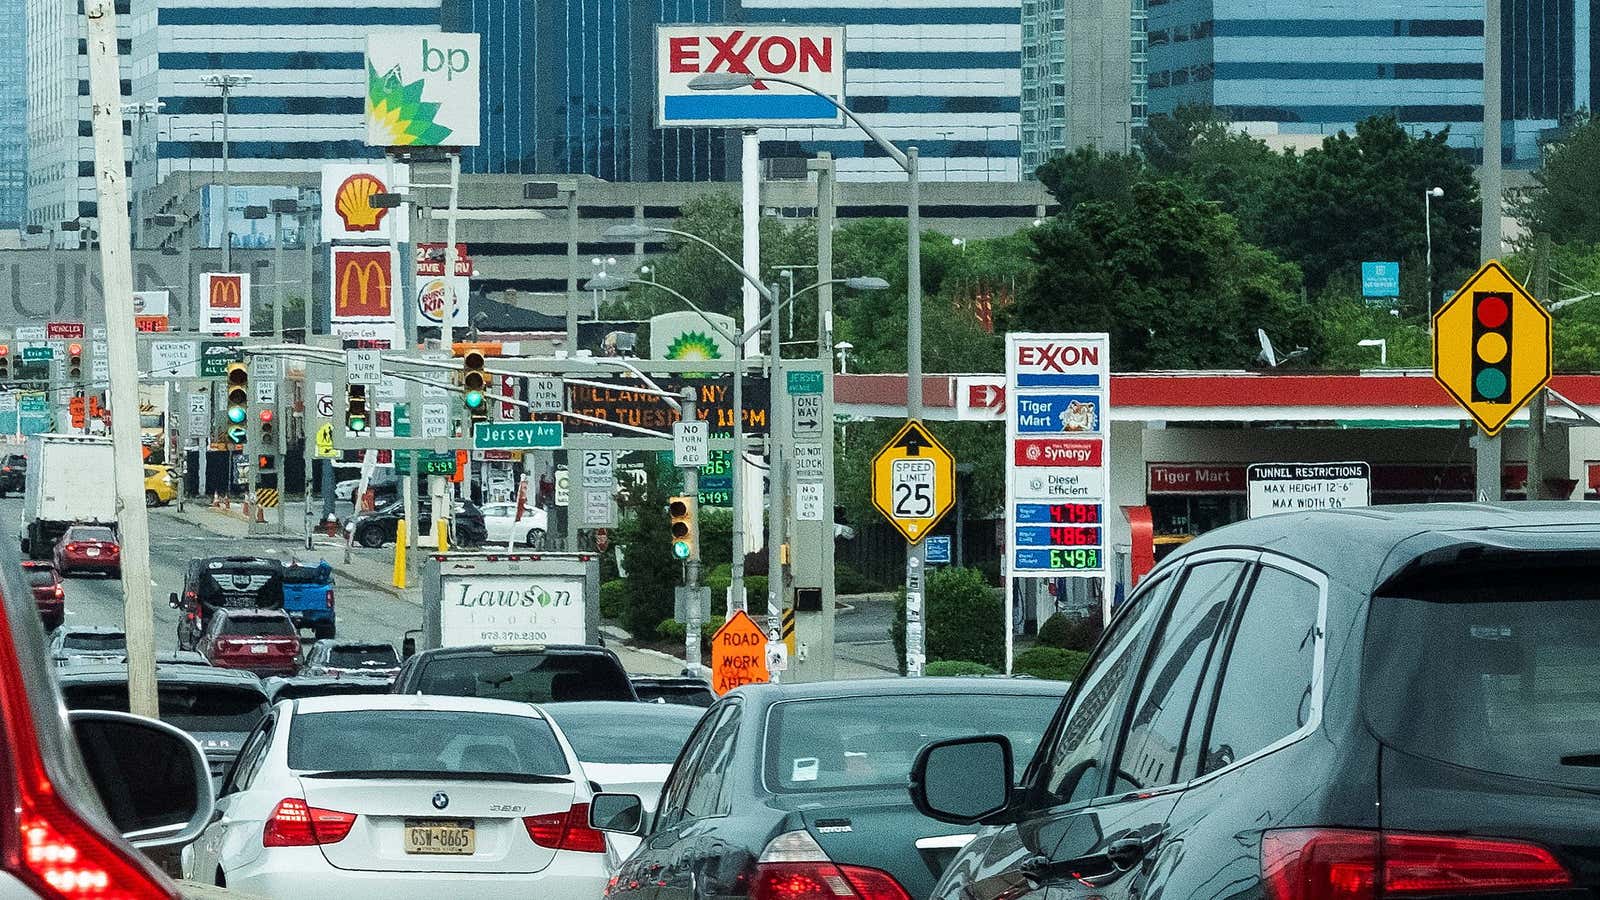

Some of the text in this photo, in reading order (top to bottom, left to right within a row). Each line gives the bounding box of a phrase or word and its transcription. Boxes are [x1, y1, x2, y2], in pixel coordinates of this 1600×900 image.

[422, 39, 470, 81] bp
[669, 31, 832, 90] EXXON
[1018, 343, 1098, 372] EXXON
[788, 373, 821, 383] JERSEY
[538, 381, 553, 390] NO
[536, 391, 557, 399] TURN
[701, 385, 729, 402] NY
[797, 397, 818, 407] ONE
[1020, 400, 1052, 414] Tiger
[614, 408, 710, 428] TUESDY
[797, 408, 819, 417] WAY
[1020, 414, 1051, 426] Mart
[482, 426, 555, 444] Jersey Ave
[683, 425, 698, 434] NO
[795, 447, 821, 456] DO NOT
[1044, 446, 1092, 461] Synergy
[585, 452, 610, 467] 25
[682, 454, 700, 462] RED
[796, 459, 823, 468] BLOCK
[896, 463, 931, 472] SPEED
[1254, 466, 1362, 478] TUNNEL RESTRICTIONS
[899, 473, 927, 482] LIMIT
[1048, 474, 1079, 485] Diesel
[1155, 468, 1231, 484] Tiger Mart
[1048, 485, 1088, 495] Efficient
[1264, 484, 1285, 493] MAX
[1289, 483, 1322, 492] HEIGHT
[895, 483, 931, 515] 25
[1272, 499, 1293, 508] MAX
[1297, 498, 1325, 508] WIDTH
[1049, 503, 1087, 522] 4.79
[1049, 527, 1087, 545] 4.86
[1050, 549, 1086, 568] 6.49
[723, 632, 760, 646] ROAD
[722, 655, 760, 669] WORK
